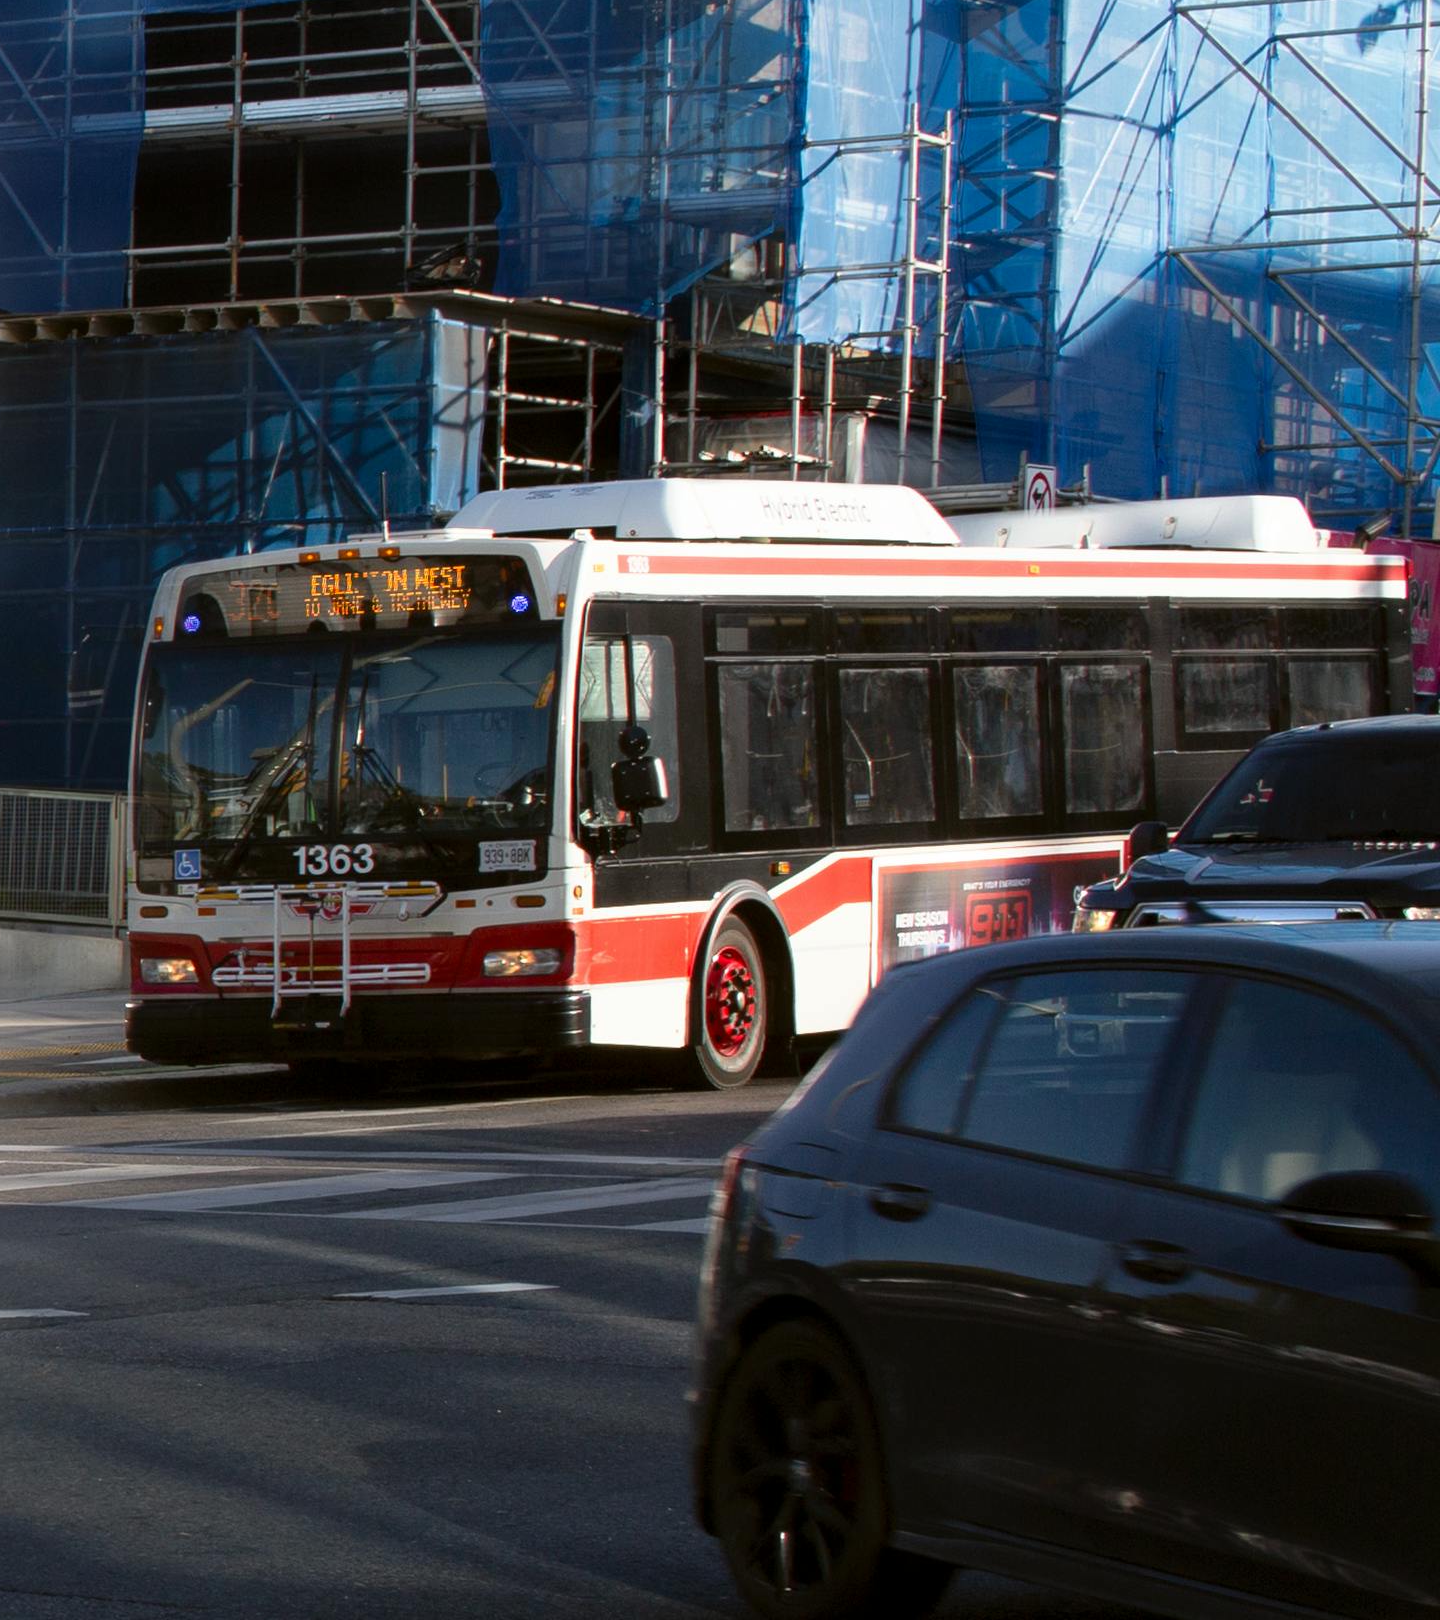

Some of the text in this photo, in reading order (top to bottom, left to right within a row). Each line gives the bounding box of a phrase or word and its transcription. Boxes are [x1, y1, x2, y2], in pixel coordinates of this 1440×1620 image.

[760, 492, 871, 524] Hybrid Electric
[415, 565, 467, 590] WEST
[304, 597, 321, 617] TO
[328, 595, 365, 616] JANE
[371, 594, 384, 613] &
[293, 844, 375, 876] 1363
[896, 910, 948, 928] NEW SEASON
